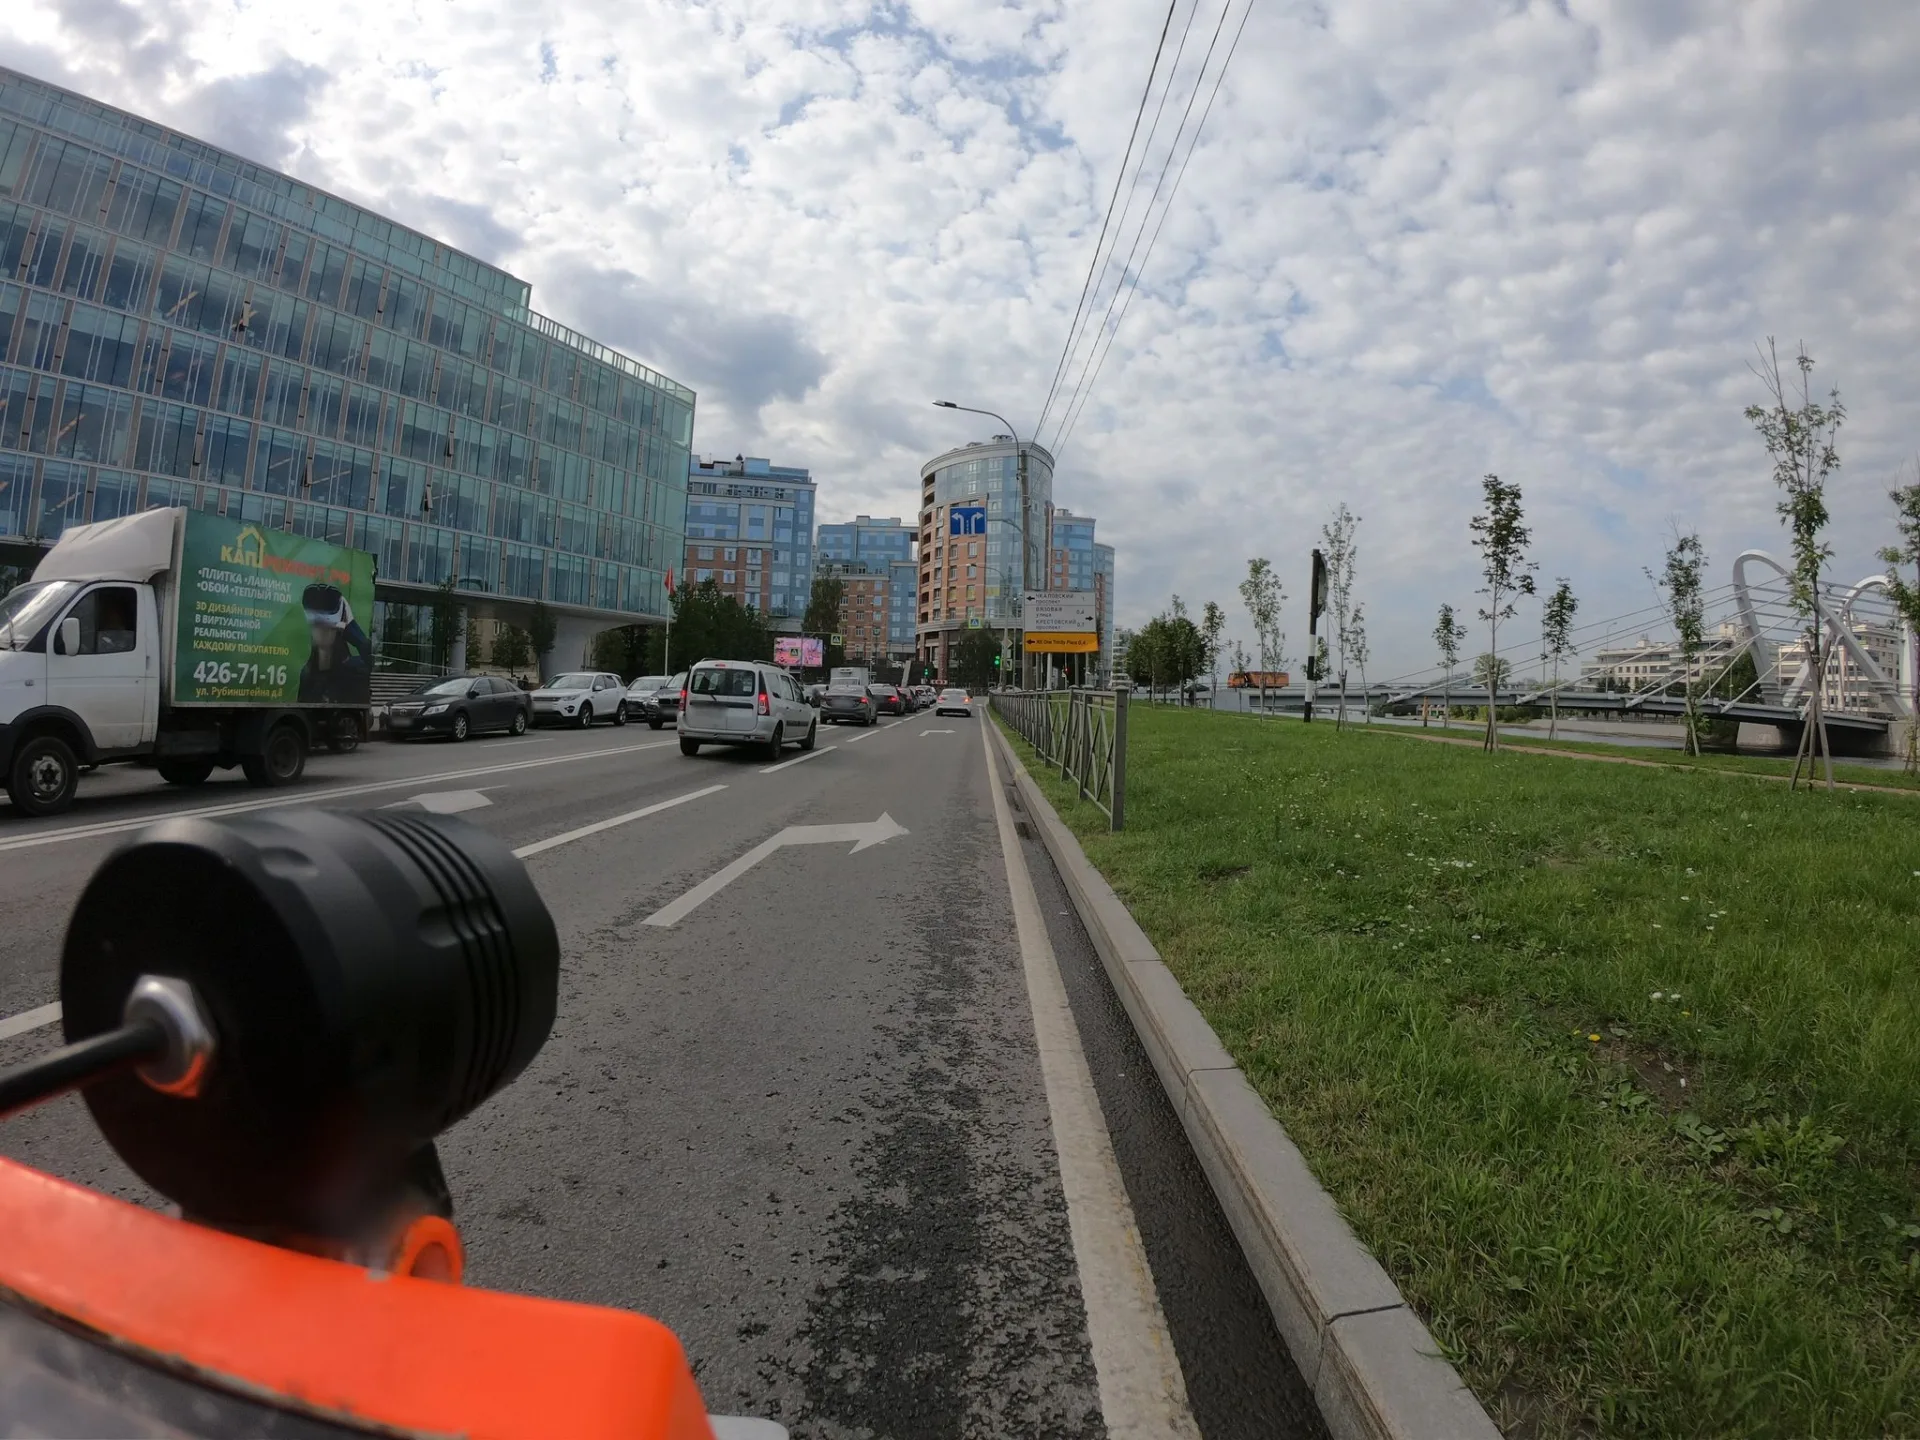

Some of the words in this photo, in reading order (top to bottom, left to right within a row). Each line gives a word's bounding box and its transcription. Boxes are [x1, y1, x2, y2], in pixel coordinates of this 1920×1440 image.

[274, 592, 292, 604] ПОЛ
[196, 601, 207, 611] 3D
[208, 602, 243, 615] ДИЗАЙН
[244, 608, 272, 618] ПРОЕКТ
[195, 614, 202, 623] В
[202, 614, 260, 630] ВИРТУАЛЬНОЙ
[194, 627, 248, 640] РЕАЛЬНОСТИ
[193, 640, 237, 652] КАЖДОМУ
[238, 644, 290, 656] ПОКУПАТЕЛЮ
[193, 660, 287, 685] 426-71-16
[195, 687, 209, 698] ул.
[212, 686, 270, 698] Рубинштейна
